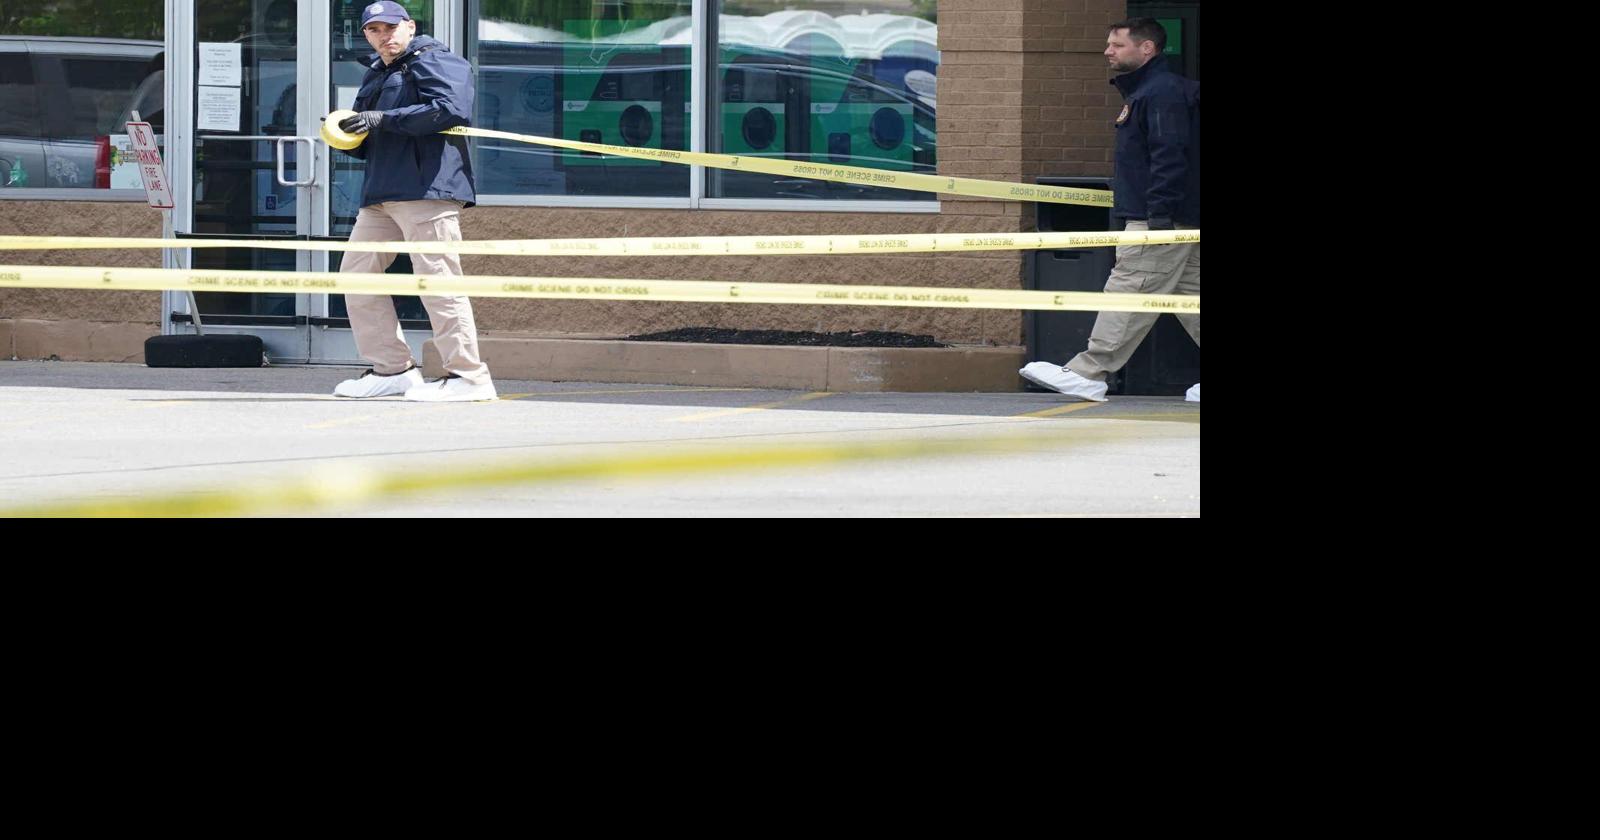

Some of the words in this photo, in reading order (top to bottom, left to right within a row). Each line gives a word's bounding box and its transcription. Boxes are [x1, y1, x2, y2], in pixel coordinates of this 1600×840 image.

[134, 128, 147, 146] NO
[135, 149, 160, 165] PARKING
[144, 167, 158, 178] FIRE
[148, 180, 163, 191] LANE
[0, 272, 21, 281] OSS
[187, 276, 219, 285] CRIME
[224, 277, 258, 287] SCENE
[263, 278, 277, 287] DO
[281, 278, 299, 287] NOT
[303, 278, 336, 288] CROSS
[502, 283, 533, 292] CRIME
[538, 284, 571, 293] SCENE
[576, 285, 590, 294] DO
[594, 286, 611, 294] NOT
[615, 286, 649, 295] CROSS
[815, 290, 849, 299] CRIME
[853, 291, 889, 300] SCENE
[893, 293, 908, 301] DO
[912, 294, 931, 302] NOT
[934, 294, 969, 303] CROSS
[1143, 300, 1177, 309] CRIME
[1181, 301, 1200, 309] SCE
